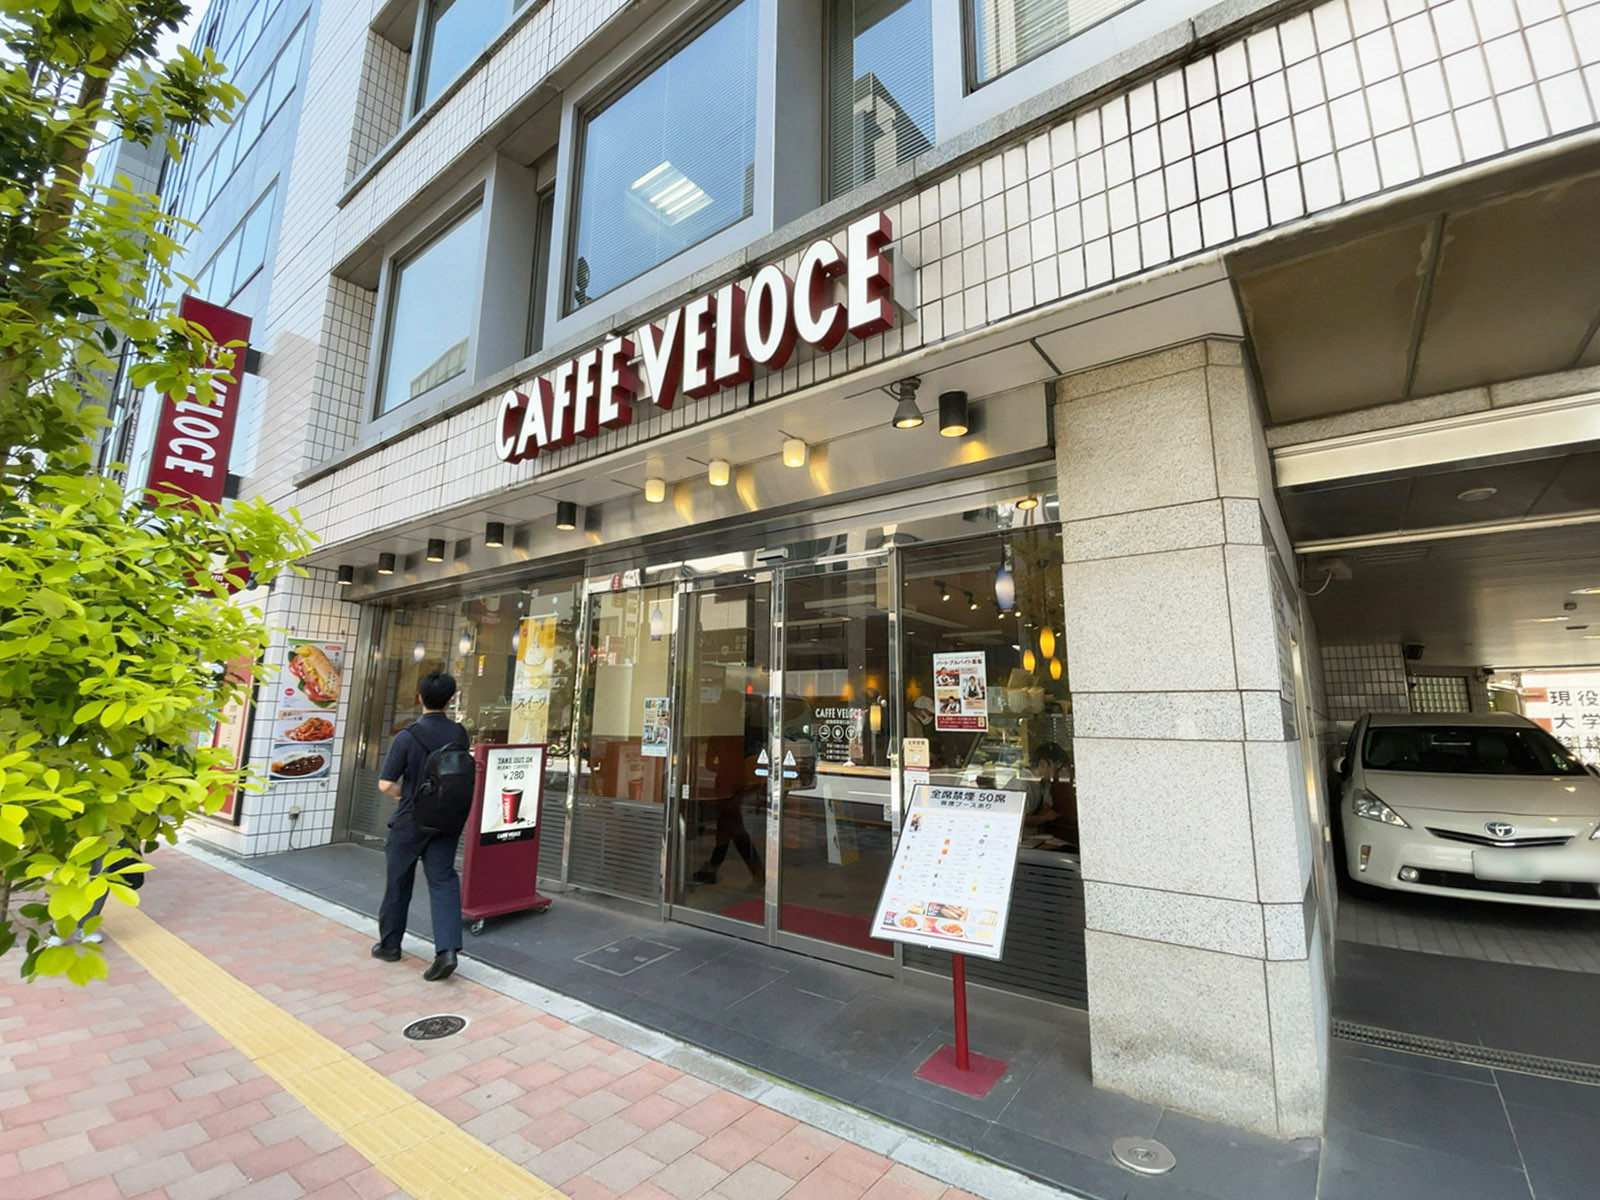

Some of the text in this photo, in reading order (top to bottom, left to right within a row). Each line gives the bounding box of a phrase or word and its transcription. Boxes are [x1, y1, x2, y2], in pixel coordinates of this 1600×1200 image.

[495, 211, 892, 463] CAFFÈ VELOCE
[514, 696, 547, 711] スイーツ
[1549, 690, 1600, 707] 現役
[1554, 713, 1600, 730] 大学
[930, 789, 1007, 803] 全席禁煙 50席
